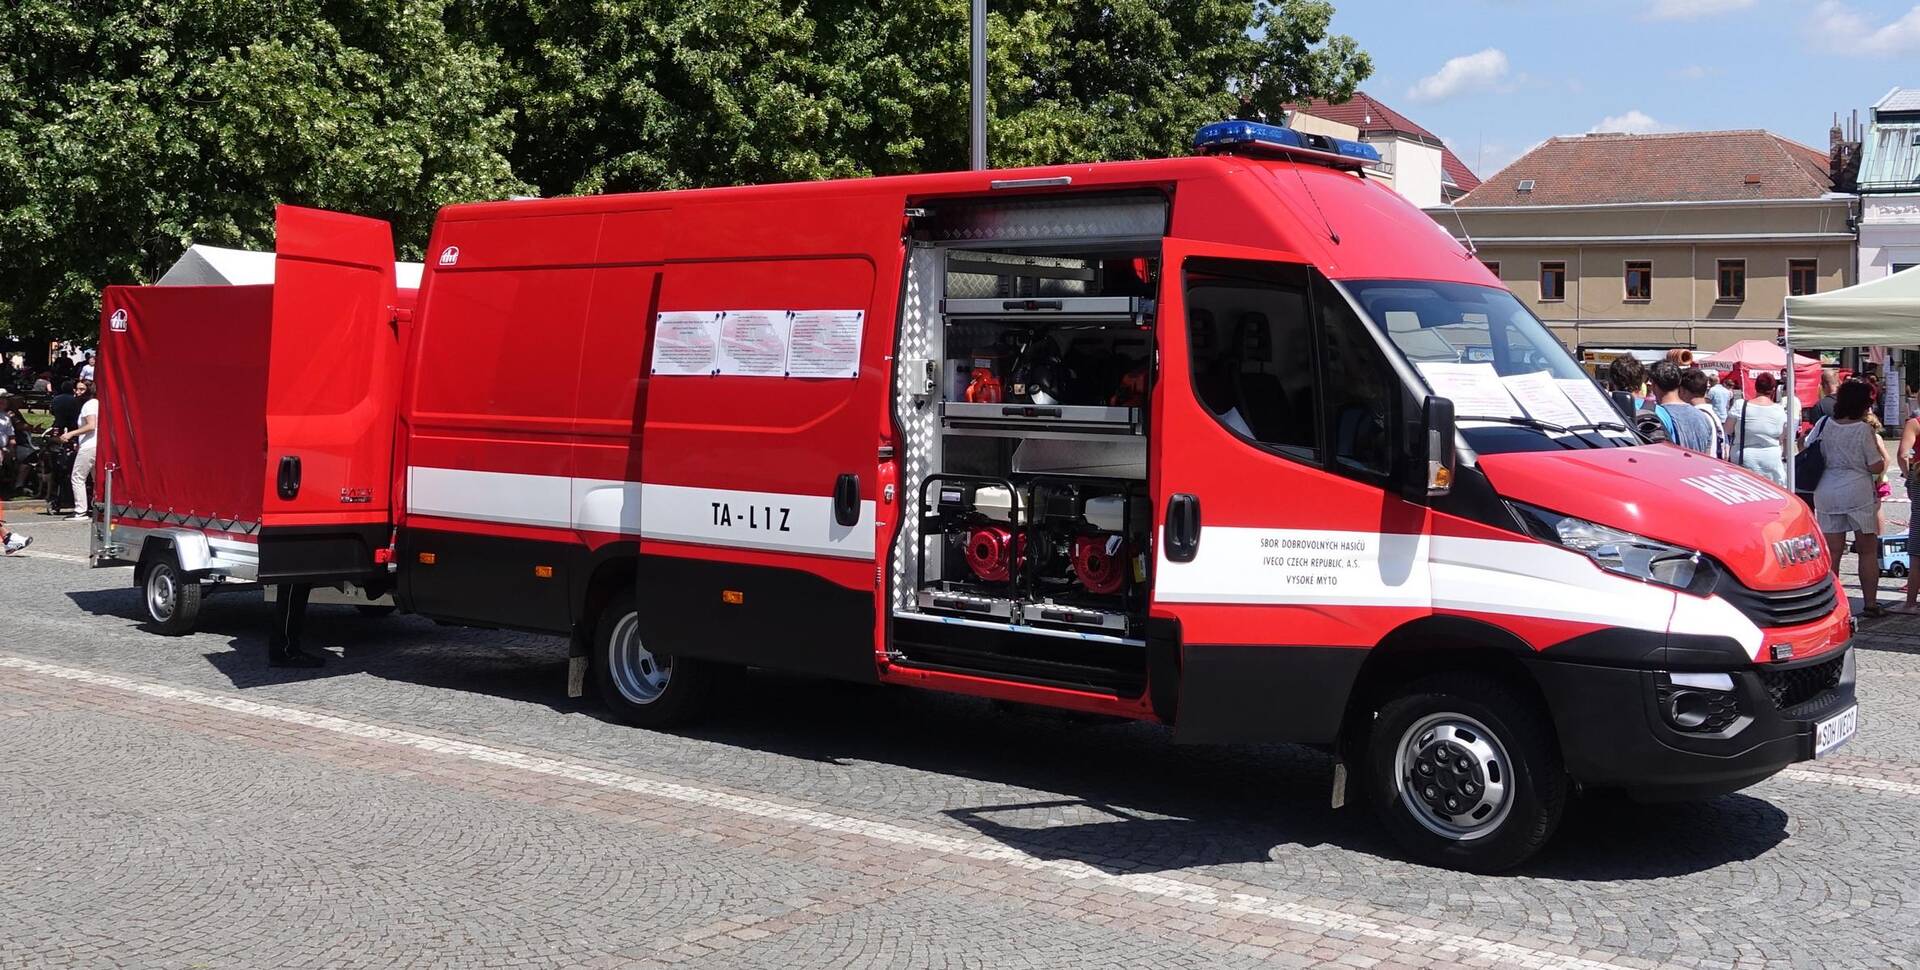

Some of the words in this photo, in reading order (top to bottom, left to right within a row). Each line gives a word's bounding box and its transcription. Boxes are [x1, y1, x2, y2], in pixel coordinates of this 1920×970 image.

[1260, 538, 1279, 548] SBOR
[1281, 538, 1338, 550] DOBROVOLNÝCH
[1771, 533, 1820, 569] IVECO
[1263, 556, 1284, 567] IVECO
[1286, 557, 1309, 567] CZECH
[1346, 559, 1361, 568] A.S.
[1822, 720, 1836, 747] SDH
[1836, 711, 1854, 739] IVECO
